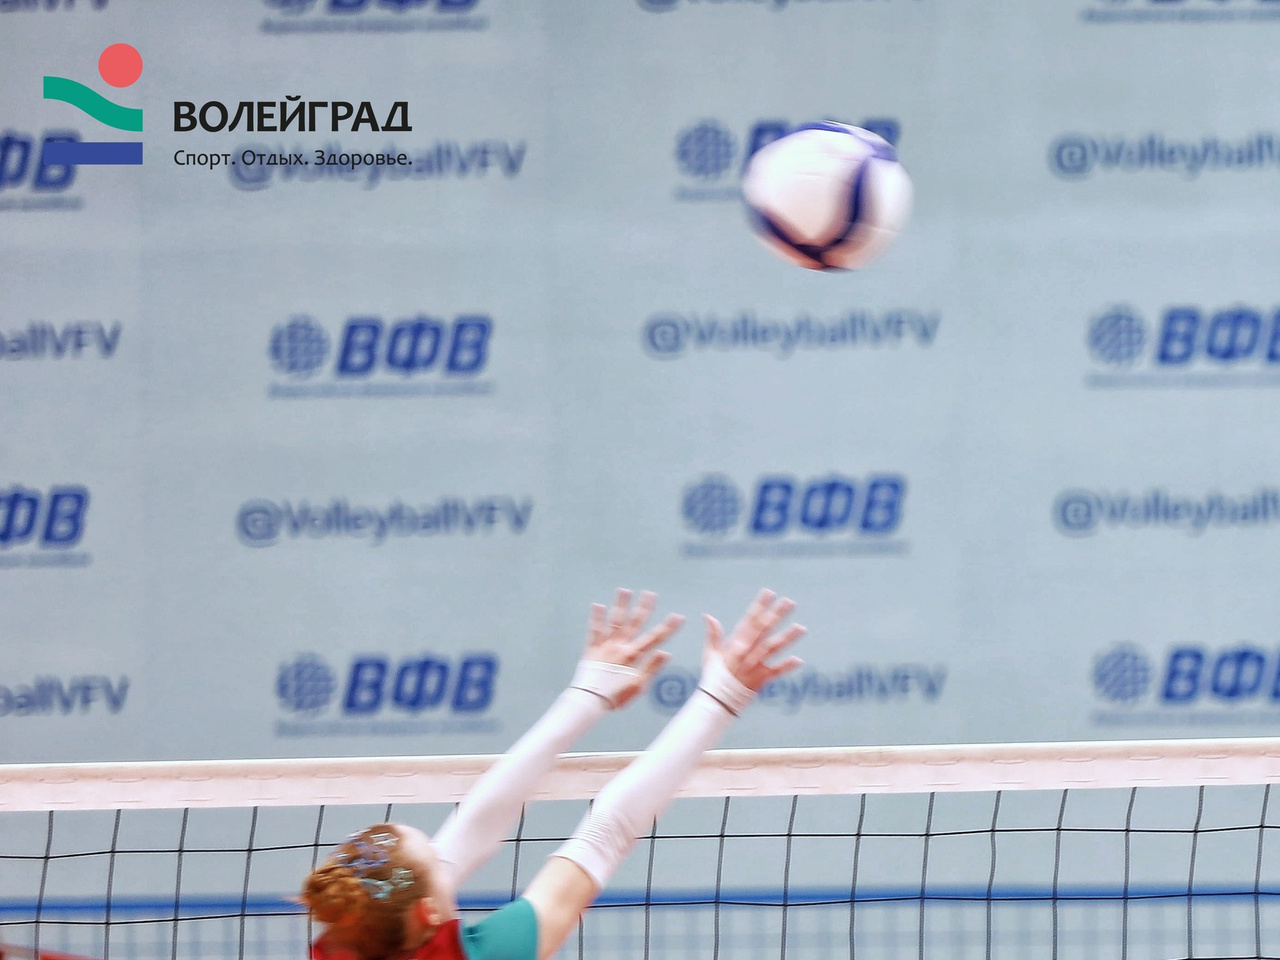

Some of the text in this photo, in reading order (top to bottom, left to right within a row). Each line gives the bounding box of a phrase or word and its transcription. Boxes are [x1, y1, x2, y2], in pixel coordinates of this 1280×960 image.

[337, 316, 491, 376] ВФВ
[749, 474, 905, 536] ВФВ
[342, 652, 498, 715] ВФВ
